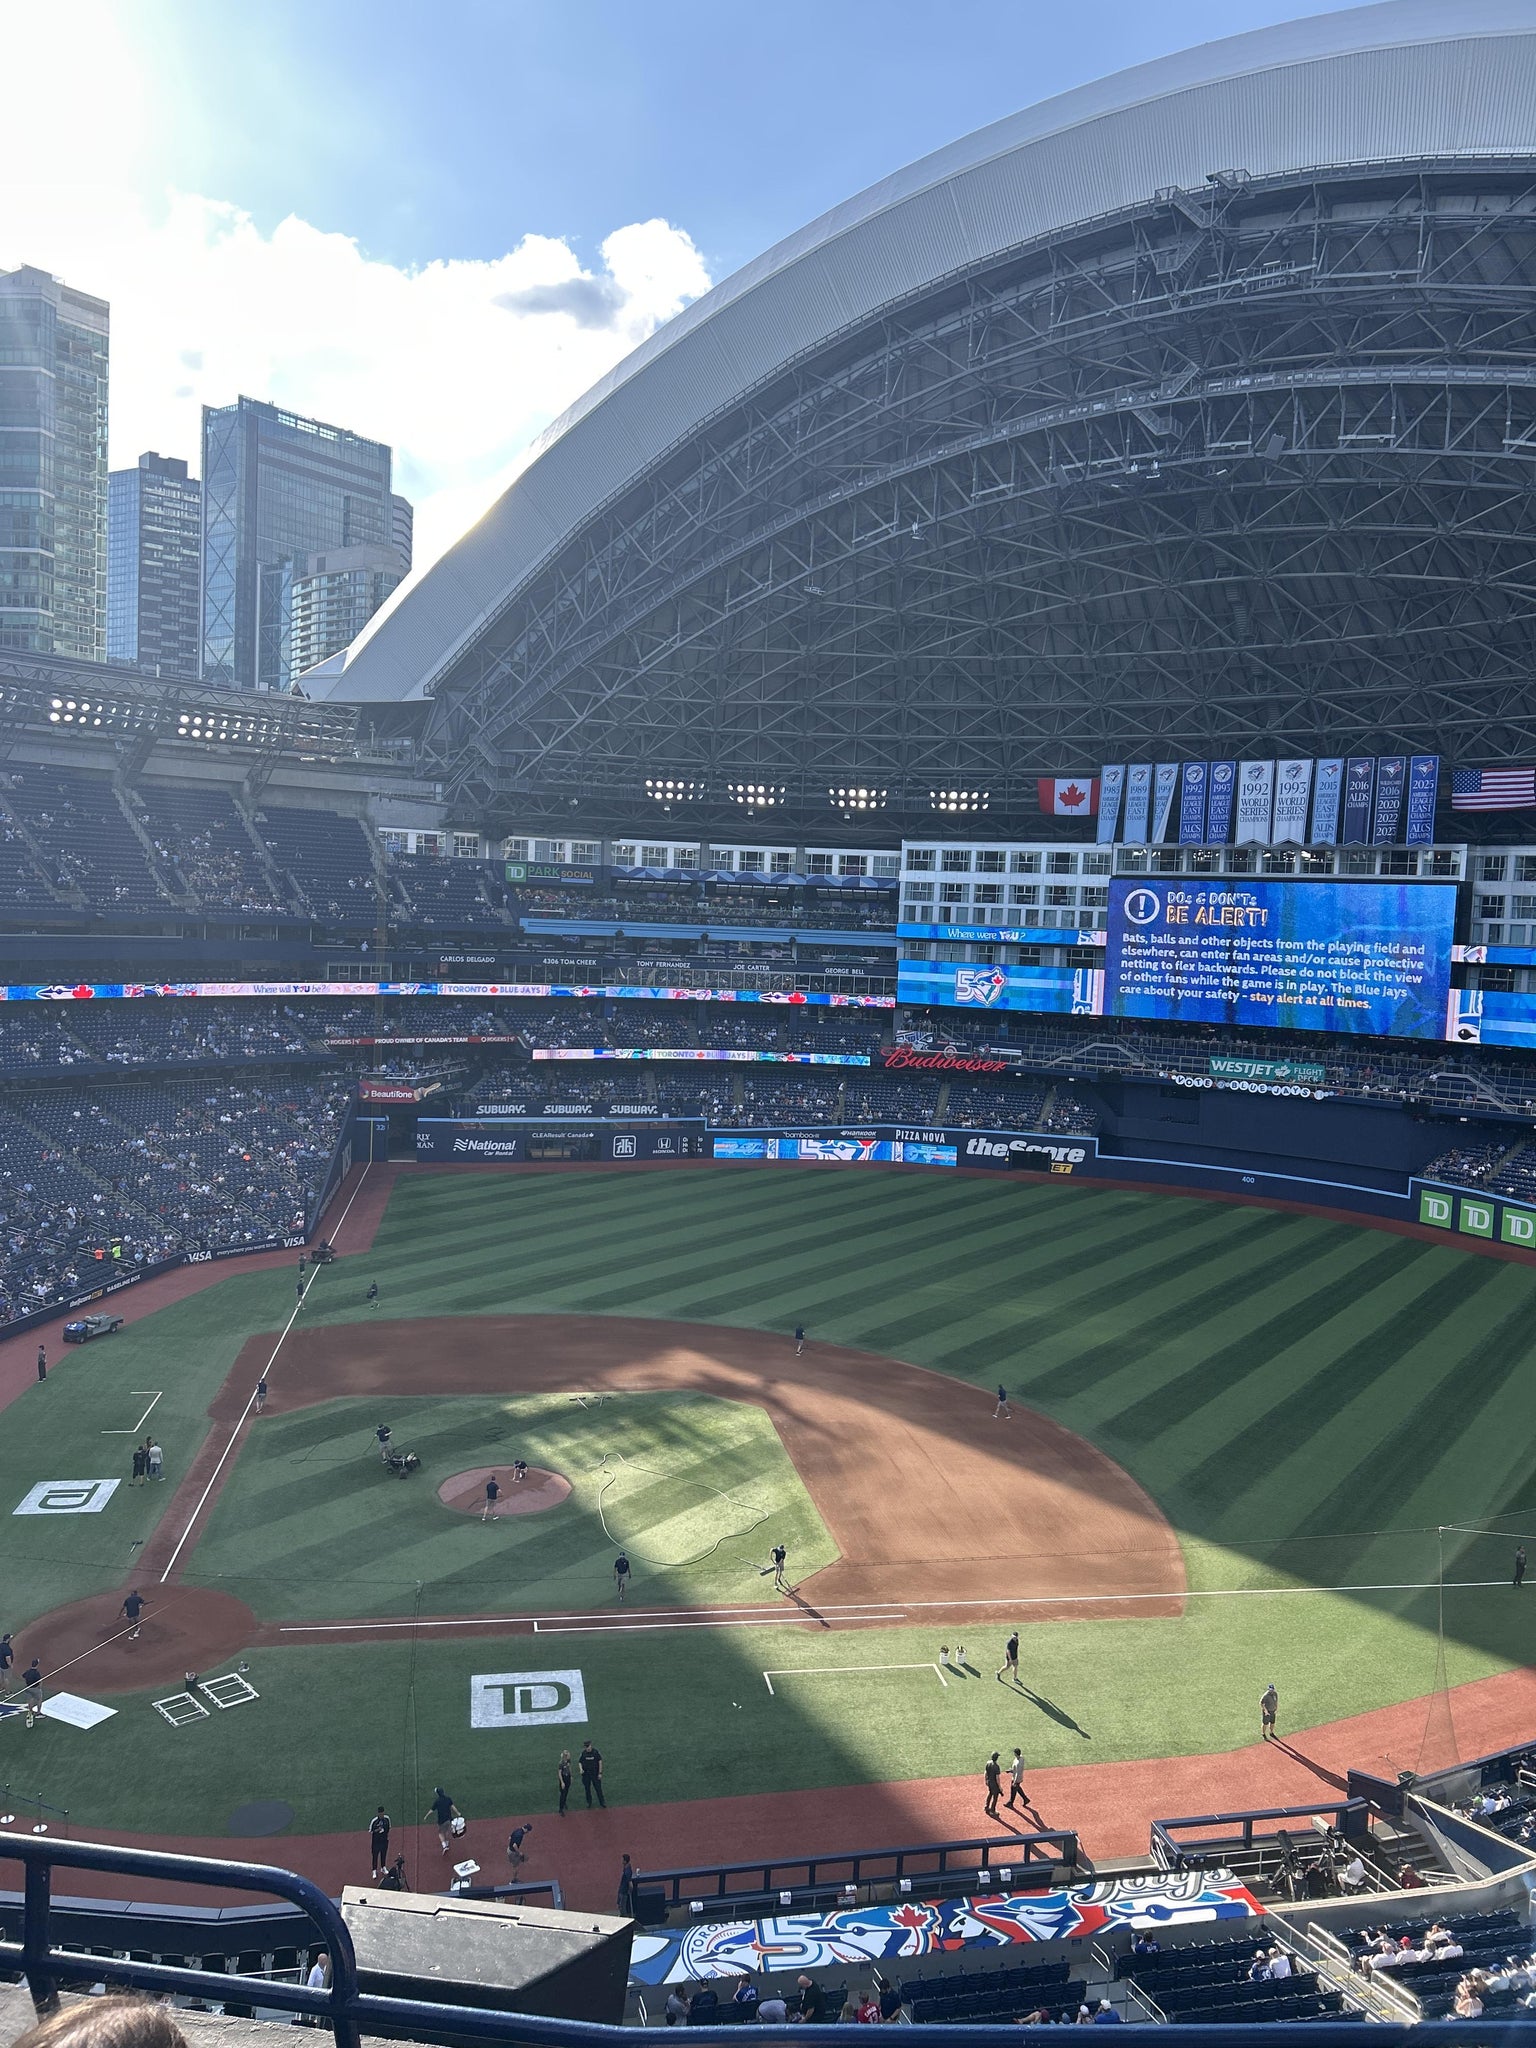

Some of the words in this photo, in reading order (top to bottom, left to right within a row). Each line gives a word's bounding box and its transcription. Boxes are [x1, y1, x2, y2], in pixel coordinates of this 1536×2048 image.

[1185, 785, 1202, 793] 1992
[1213, 784, 1230, 793] 1993
[1243, 783, 1269, 795] 1992
[1280, 782, 1307, 794] 1993
[1320, 781, 1338, 790] 2015
[1350, 781, 1369, 790] 2016
[1412, 780, 1434, 789] 2025
[1380, 787, 1400, 795] 2016
[1241, 798, 1269, 807] WORLD
[1278, 797, 1305, 806] WORLD
[1349, 792, 1369, 802] ALDS
[1316, 804, 1336, 812] EAST
[1378, 800, 1399, 809] 2020
[1411, 804, 1431, 812] EAST
[1240, 807, 1268, 815] SERIES
[1277, 806, 1305, 815] SERIES
[1377, 814, 1397, 822] 2022
[1210, 824, 1228, 832] ALCS
[1409, 824, 1430, 833] ALCS
[507, 866, 525, 879] TD
[528, 866, 560, 878] PARK
[561, 870, 594, 879] SOCIAL
[1196, 893, 1206, 904] &
[1166, 905, 1190, 924] BE
[1194, 907, 1268, 927] ALERT!
[948, 928, 975, 939] Where
[977, 931, 997, 940] were
[1123, 933, 1148, 944] Bats,
[1151, 934, 1176, 944] balls
[1178, 935, 1198, 945] and
[1201, 936, 1231, 946] other
[1233, 937, 1273, 950] objects
[1276, 938, 1303, 949] from
[1307, 940, 1325, 950] the
[1328, 941, 1370, 955] playing
[1373, 942, 1400, 954] field
[1402, 945, 1425, 955] and
[440, 955, 464, 963] CARLOS
[1122, 946, 1178, 958] elsewhere,
[1180, 949, 1198, 958] can
[1201, 950, 1230, 959] enter
[1232, 950, 1250, 960] fan
[1252, 953, 1283, 963] areas
[1285, 953, 1326, 964] and/or
[1328, 957, 1360, 966] cause
[1364, 958, 1424, 969] protective
[656, 961, 691, 969] FERNANDEZ
[1121, 960, 1158, 970] netting
[1161, 961, 1172, 970] to
[1175, 961, 1194, 971] flex
[1198, 962, 1258, 974] backwards.
[1261, 965, 1297, 976] Please
[1299, 967, 1314, 977] do
[1317, 969, 1337, 978] not
[1340, 969, 1370, 980] block
[1373, 971, 1392, 982] the
[1395, 972, 1422, 983] view
[448, 986, 488, 994] TORONTO
[500, 986, 519, 994] BLUE
[520, 987, 540, 995] JAYS
[1120, 971, 1132, 980] of
[1134, 972, 1163, 982] other
[1165, 973, 1188, 984] fans
[1190, 975, 1219, 985] while
[1222, 976, 1239, 986] the
[1242, 979, 1272, 989] game
[1275, 980, 1283, 989] is
[1286, 980, 1296, 989] in
[1300, 981, 1328, 994] play.
[1331, 983, 1352, 993] The
[1355, 984, 1380, 995] Blue
[1382, 986, 1407, 1000] Jays
[1144, 986, 1174, 996] about
[1178, 988, 1203, 999] your
[1205, 989, 1239, 1002] safety
[1250, 992, 1273, 1005] stay
[1277, 993, 1303, 1004] alert
[1306, 995, 1317, 1005] at
[1320, 995, 1334, 1006] all
[1337, 997, 1371, 1009] times.
[657, 1051, 695, 1059] TORONTO
[881, 1046, 1007, 1072] Budweiser
[1211, 1060, 1274, 1078] WESTJET
[1294, 1067, 1323, 1077] FLIGHT
[1177, 1075, 1212, 1088] VOTE
[1230, 1080, 1267, 1093] BLUE
[1271, 1085, 1310, 1098] JAYS
[476, 1104, 526, 1115] SUBWAY
[543, 1104, 592, 1115] SUBWAY
[610, 1104, 659, 1115] SUBWAY
[896, 1129, 919, 1142] PIZZA
[923, 1131, 946, 1144] NOVA
[467, 1139, 516, 1151] National
[1242, 1176, 1255, 1184] 400
[1424, 1196, 1449, 1221] TD
[1464, 1205, 1490, 1230] TD
[1506, 1214, 1534, 1240] TD
[282, 1236, 305, 1248] VISA
[188, 1250, 212, 1263] VISA
[38, 1483, 101, 1510] TD
[484, 1681, 571, 1715] TD
